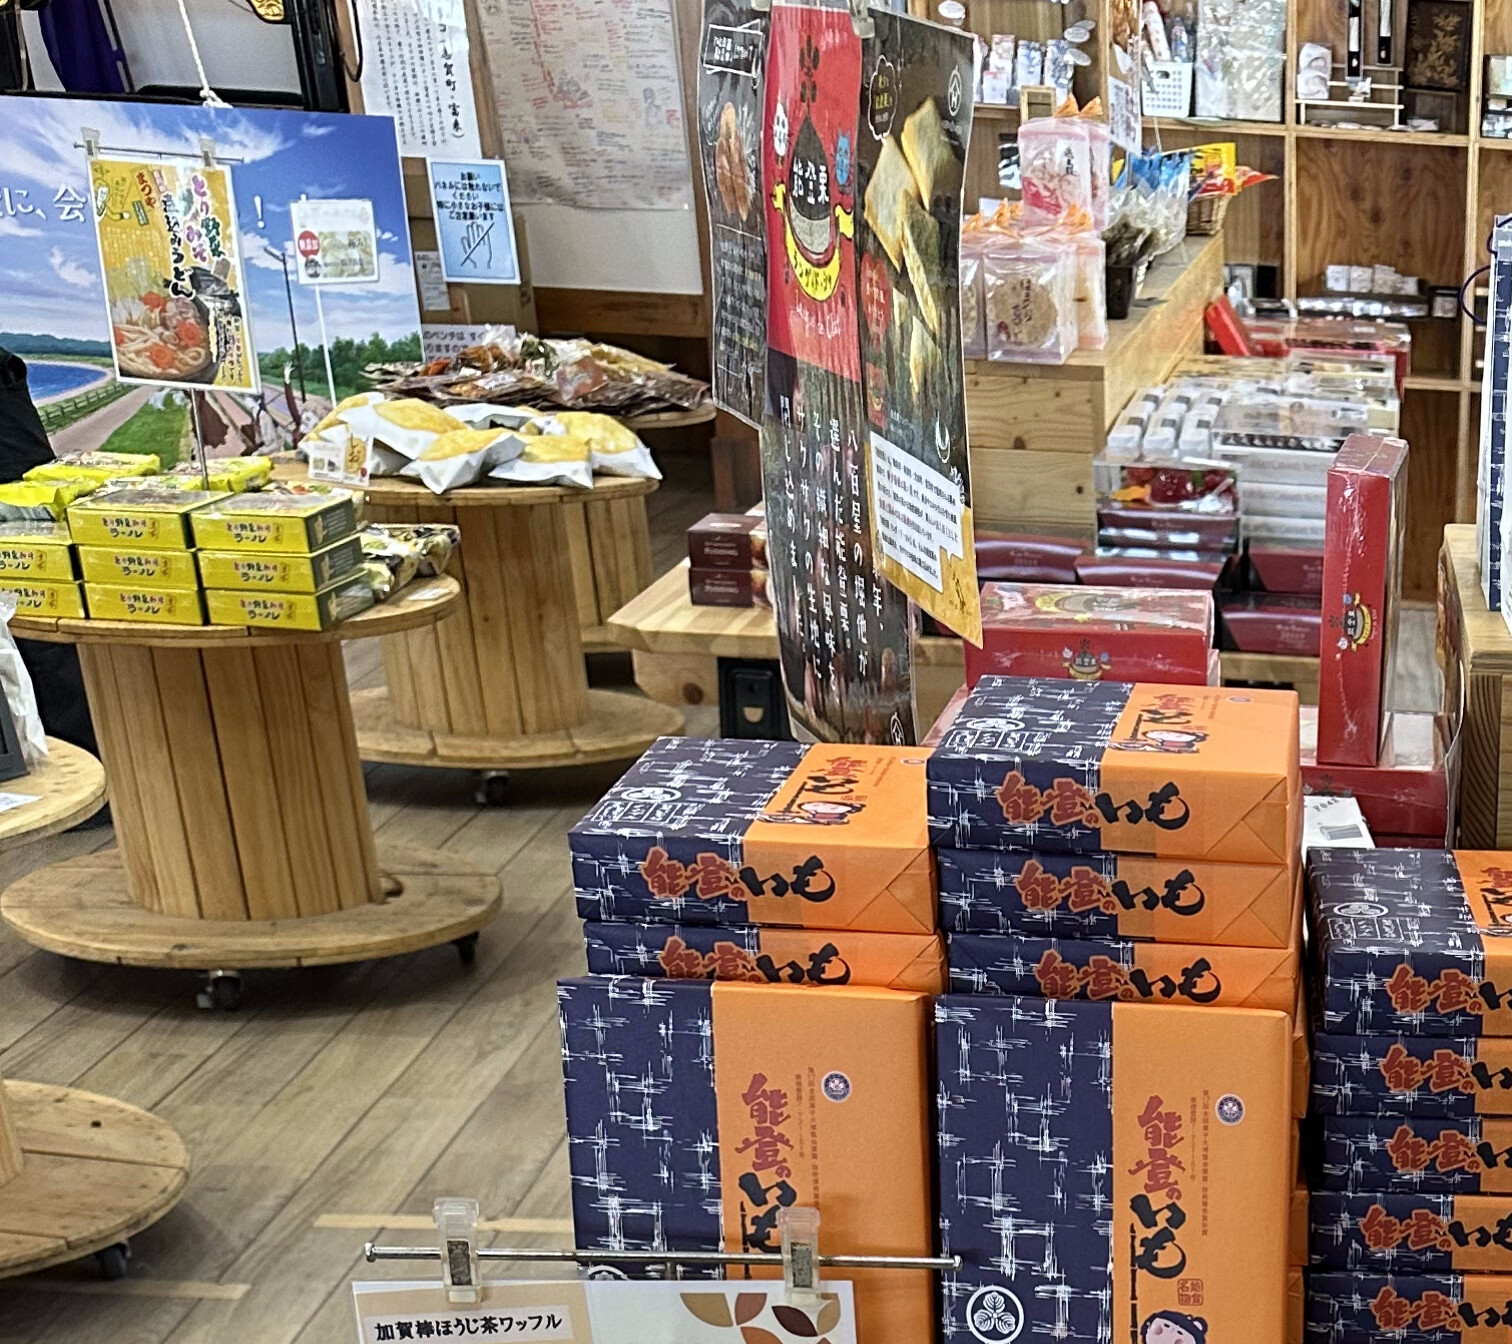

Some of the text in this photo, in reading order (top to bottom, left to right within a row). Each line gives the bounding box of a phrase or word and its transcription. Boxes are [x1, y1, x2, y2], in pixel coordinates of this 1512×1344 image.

[997, 771, 1190, 831] 能登のいも
[1015, 859, 1206, 917] 能登のいも
[1034, 948, 1222, 1003] 能登のいも
[1127, 1094, 1188, 1280] 能登のいも
[374, 1313, 563, 1342] 加賀棒ほうじ茶ワッフル
